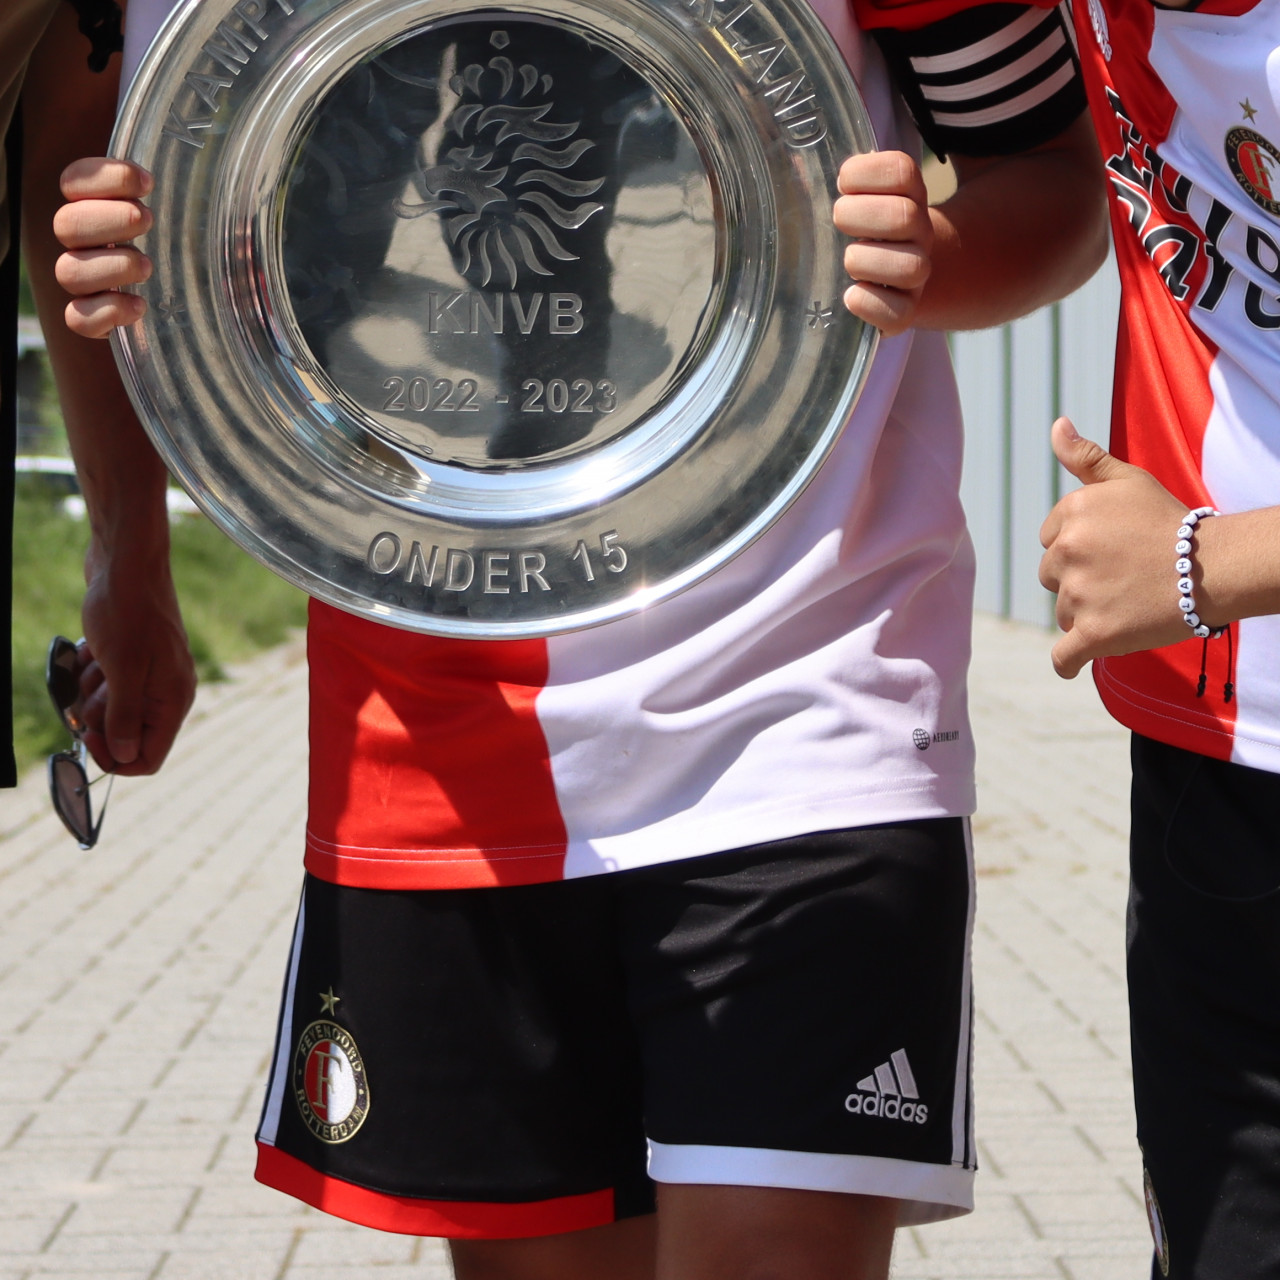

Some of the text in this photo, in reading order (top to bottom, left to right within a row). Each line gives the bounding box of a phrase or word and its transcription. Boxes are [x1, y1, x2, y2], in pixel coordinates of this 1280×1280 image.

[427, 291, 585, 335] KNVB
[382, 375, 480, 412] 2022
[520, 377, 619, 413] 2023
[367, 528, 628, 594] ONDER 15
[301, 1025, 363, 1072] FEYENOORD
[297, 1089, 364, 1140] ROTTERDAM
[844, 1091, 929, 1125] adidas
